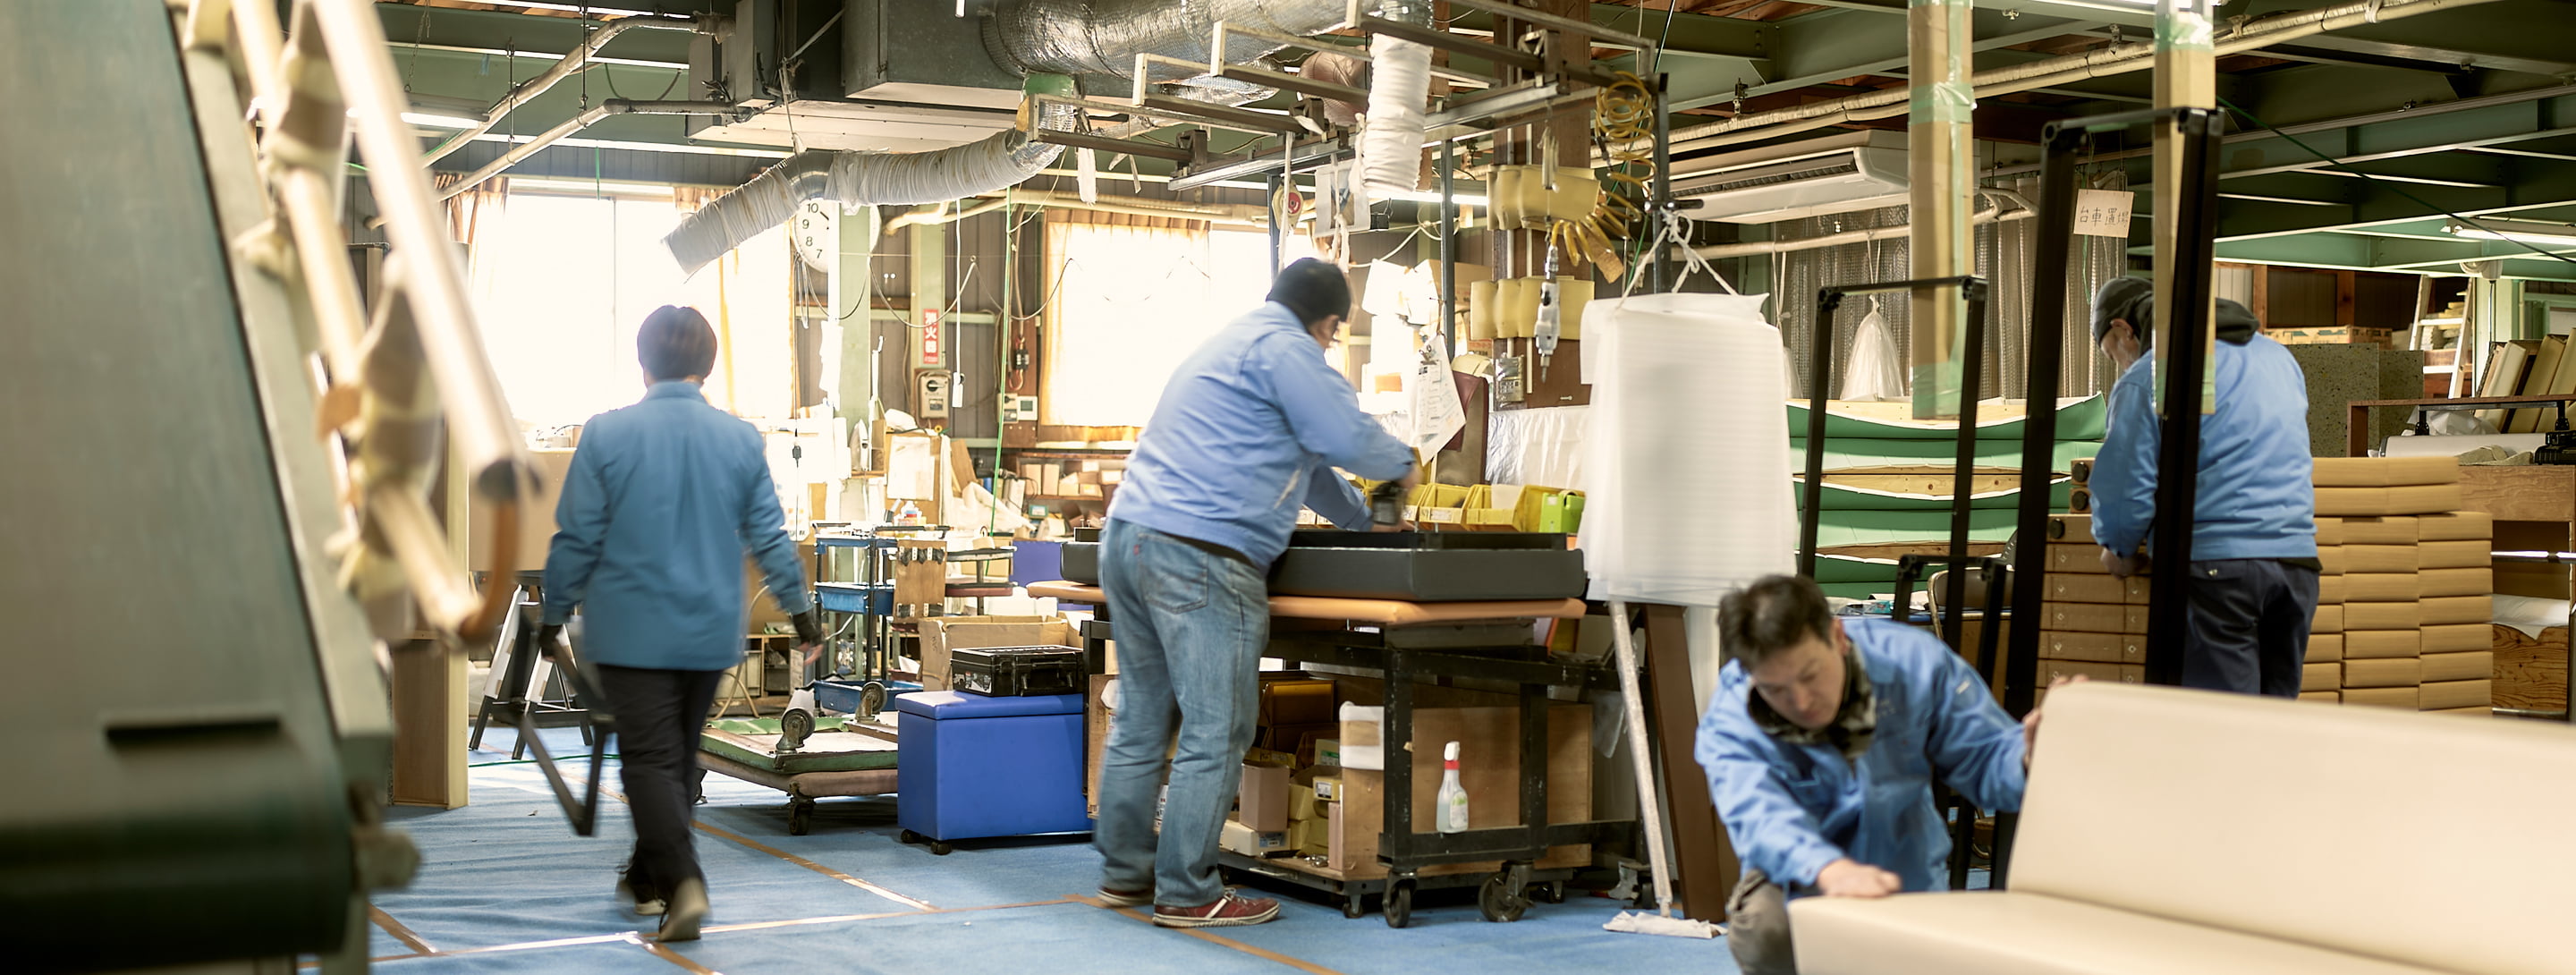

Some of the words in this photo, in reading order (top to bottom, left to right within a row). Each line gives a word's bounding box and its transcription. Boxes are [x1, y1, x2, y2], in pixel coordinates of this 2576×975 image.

[807, 203, 818, 213] 10
[802, 219, 809, 229] 9
[805, 236, 813, 247] 8
[816, 250, 822, 259] 7
